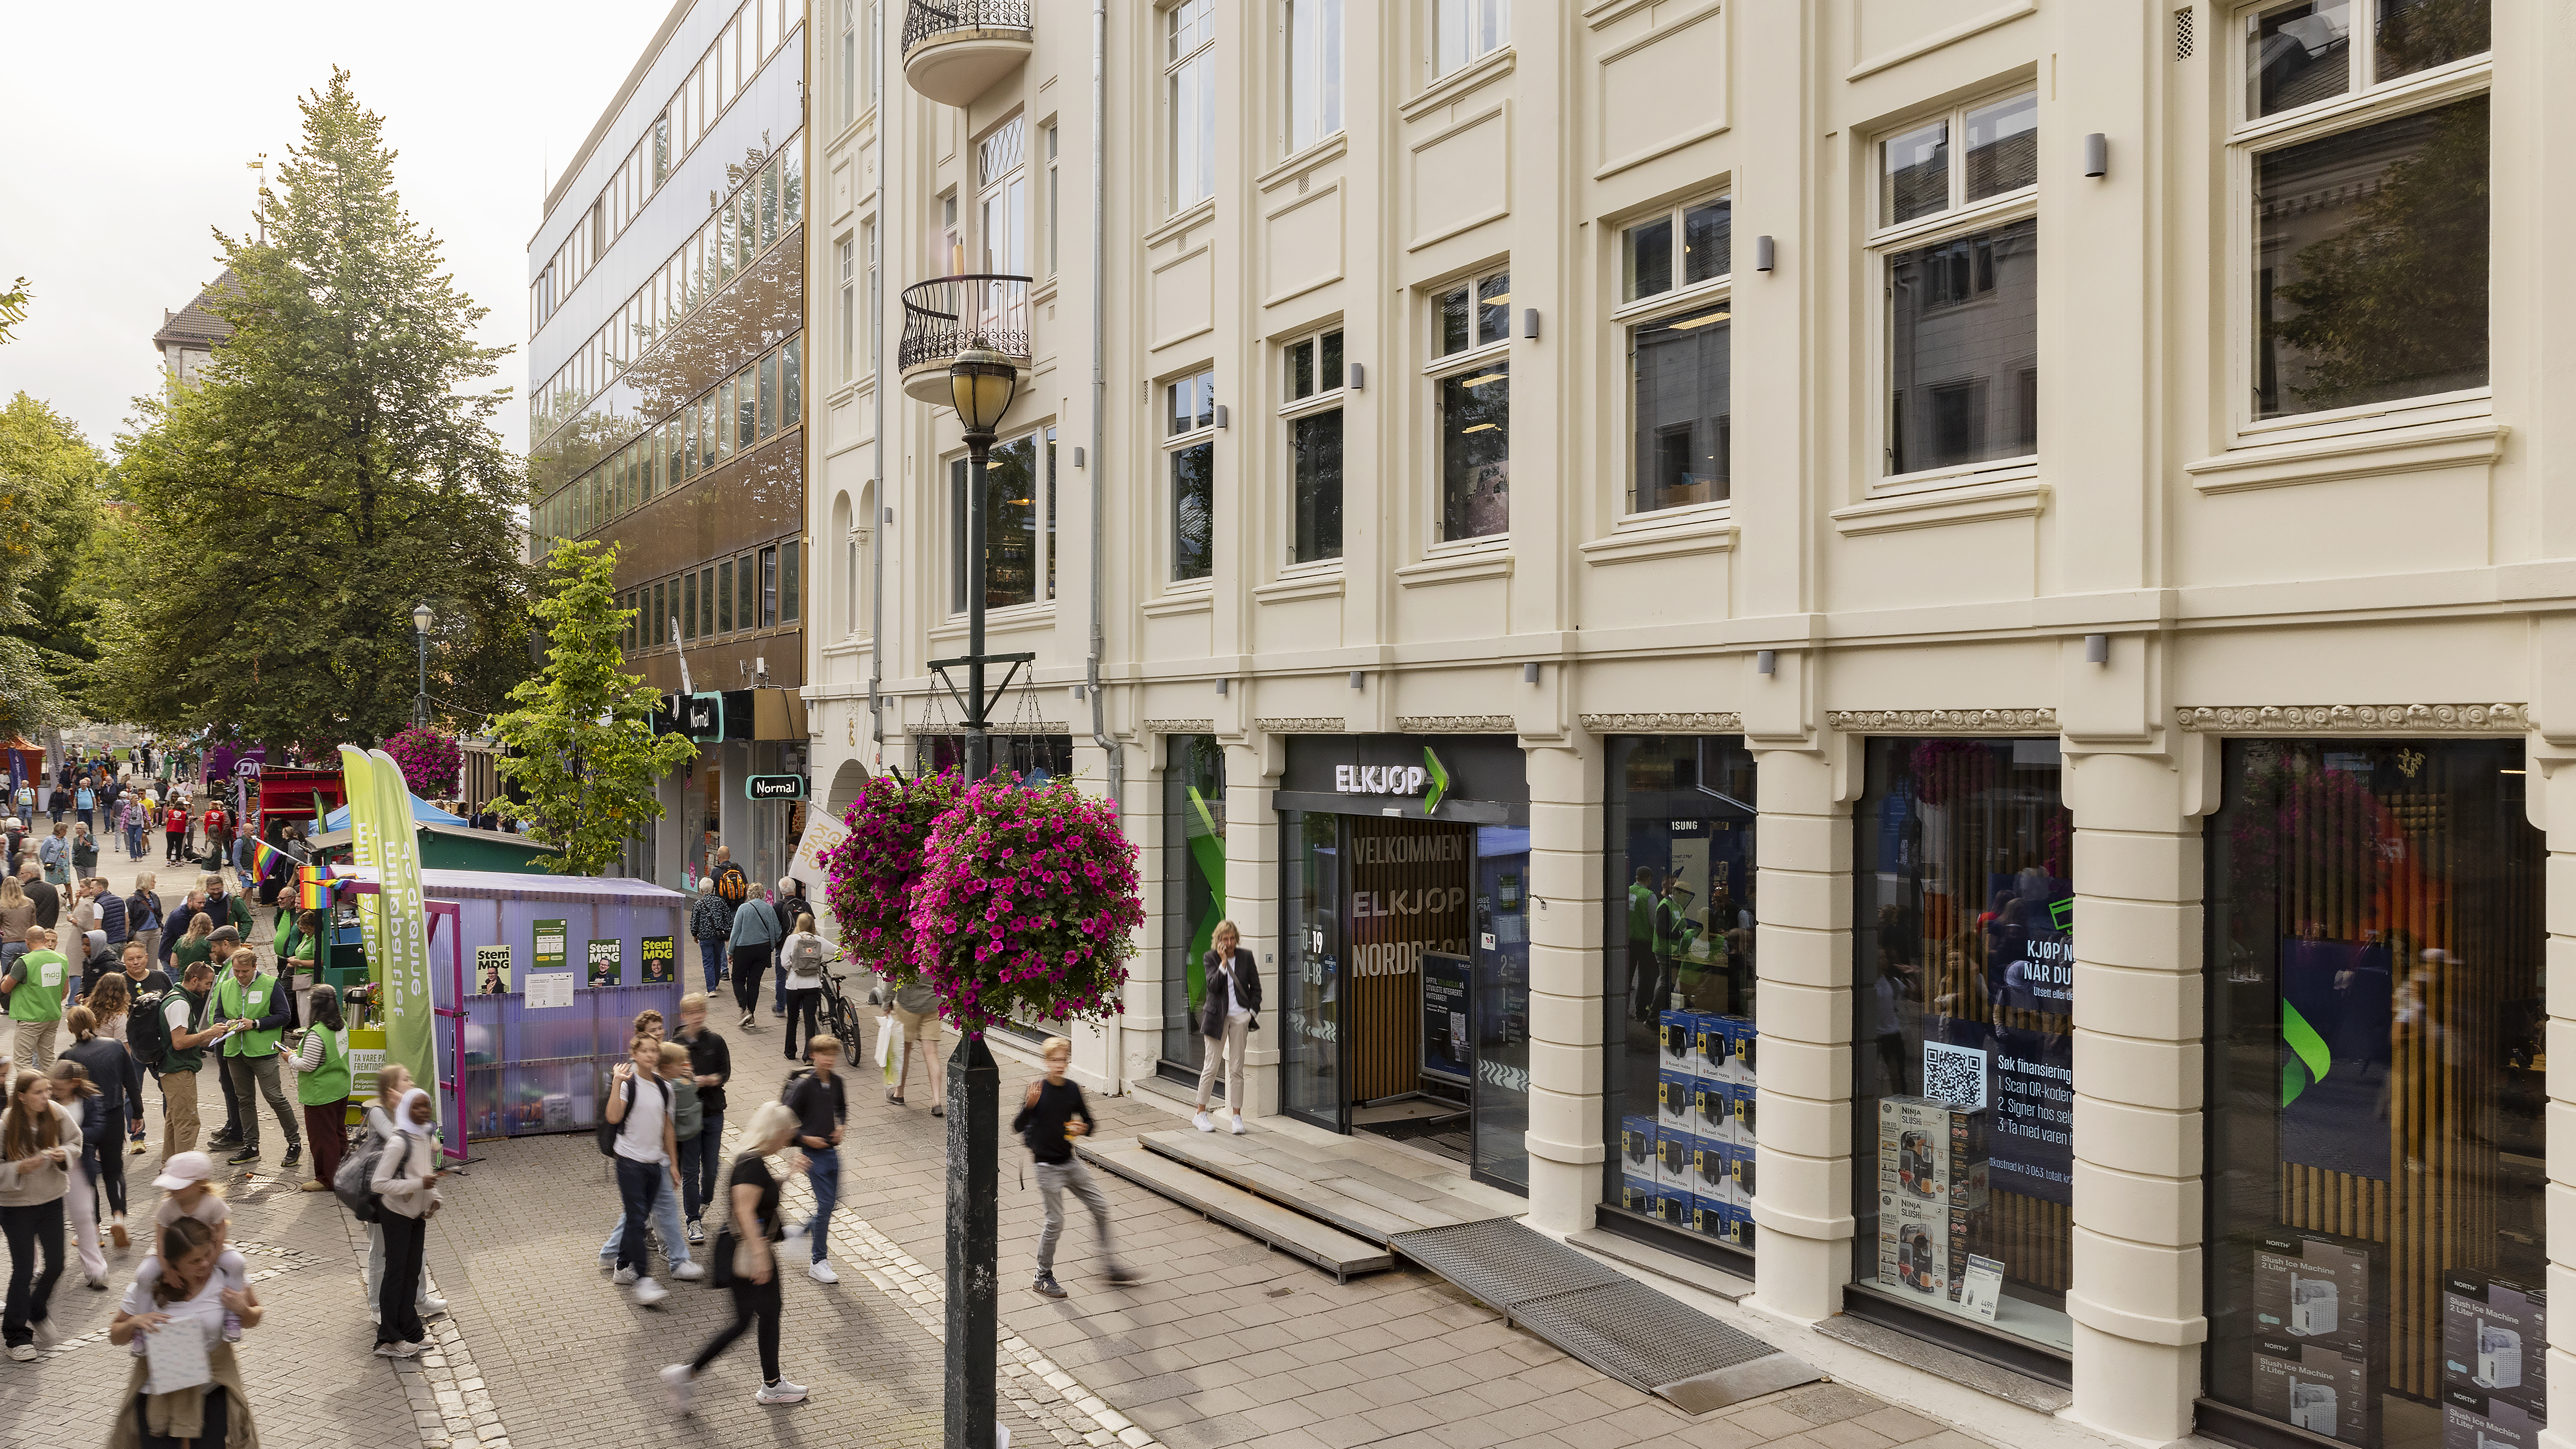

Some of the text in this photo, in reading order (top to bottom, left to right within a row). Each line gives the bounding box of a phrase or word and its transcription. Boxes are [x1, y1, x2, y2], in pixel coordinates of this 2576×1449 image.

[690, 706, 709, 728] Normal
[239, 763, 261, 777] DN
[757, 780, 795, 793] Normal
[1353, 834, 1462, 864] VELKOMMEN
[589, 943, 620, 953] Stem
[643, 940, 672, 950] Stem
[2027, 940, 2076, 962] KJØP N
[478, 951, 509, 959] Stem
[589, 952, 620, 963] MDG
[643, 949, 672, 960] MDG
[1353, 940, 1436, 977] NORDR
[478, 959, 509, 970] MDG
[2024, 960, 2071, 985] NÅR DU
[1426, 984, 1463, 997] UTVALGTE INTEGRERTE
[2034, 986, 2051, 998] Utsett
[2052, 989, 2065, 1000] eller
[378, 1053, 386, 1061] PÅ
[1998, 1055, 2071, 1084] Søk finansiering
[2005, 1077, 2027, 1094] Scan
[2030, 1082, 2072, 1103] QR-koden
[1902, 1106, 1921, 1117] NINJA
[1998, 1096, 2006, 1111] 2.
[2009, 1098, 2034, 1117] Signer
[2038, 1106, 2055, 1121] hos
[1902, 1116, 1922, 1126] SLUSHi
[1998, 1117, 2006, 1132] 3.
[2008, 1119, 2017, 1134] Ta
[2019, 1123, 2039, 1139] med
[2042, 1129, 2067, 1145] varen
[1989, 1157, 2017, 1171] ttkostnad
[2018, 1162, 2024, 1173] kr
[2046, 1169, 2062, 1183] totalt
[2064, 1173, 2070, 1184] kr
[1901, 1199, 1921, 1210] NINJA
[1901, 1208, 1921, 1219] SLUSHi
[2261, 1255, 2335, 1275] Slush Ice Machine
[2268, 1264, 2287, 1272] Liter
[2450, 1297, 2519, 1324] Slush Ice Machine
[2457, 1307, 2474, 1318] Liter
[2260, 1358, 2334, 1380] Slush Ice Machine
[2267, 1366, 2286, 1376] Liter
[2450, 1409, 2520, 1440] Slush Ice Machine
[2456, 1419, 2474, 1430] Liter
